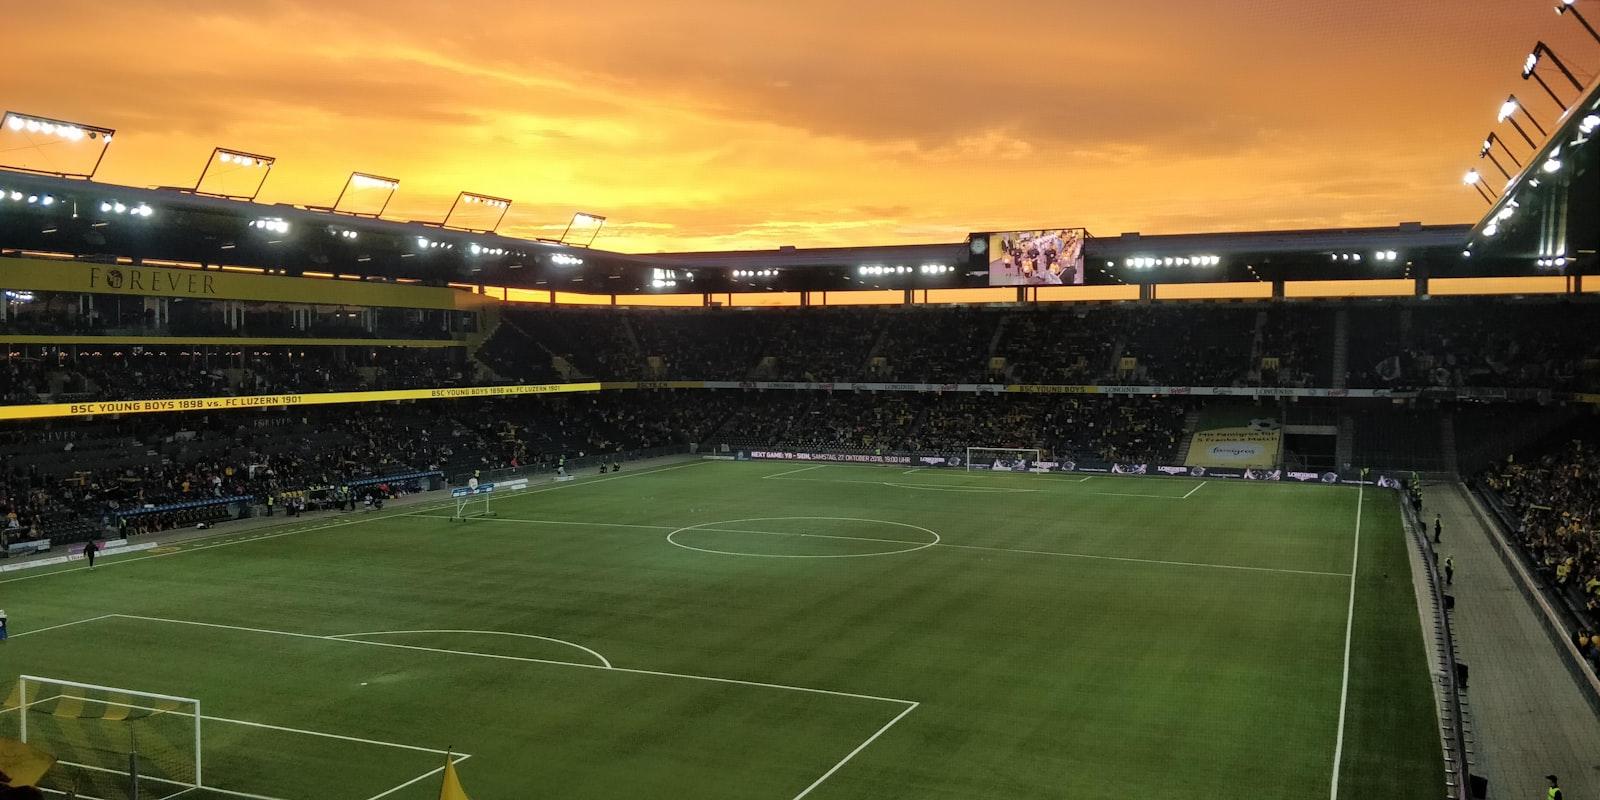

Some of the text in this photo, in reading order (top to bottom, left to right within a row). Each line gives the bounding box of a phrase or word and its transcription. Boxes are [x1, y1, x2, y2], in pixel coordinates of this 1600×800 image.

[70, 404, 95, 414] BSC
[99, 403, 141, 412] YOUNG
[144, 401, 174, 410] BOYS
[179, 400, 203, 408] 1898
[241, 396, 279, 405] LUZERN
